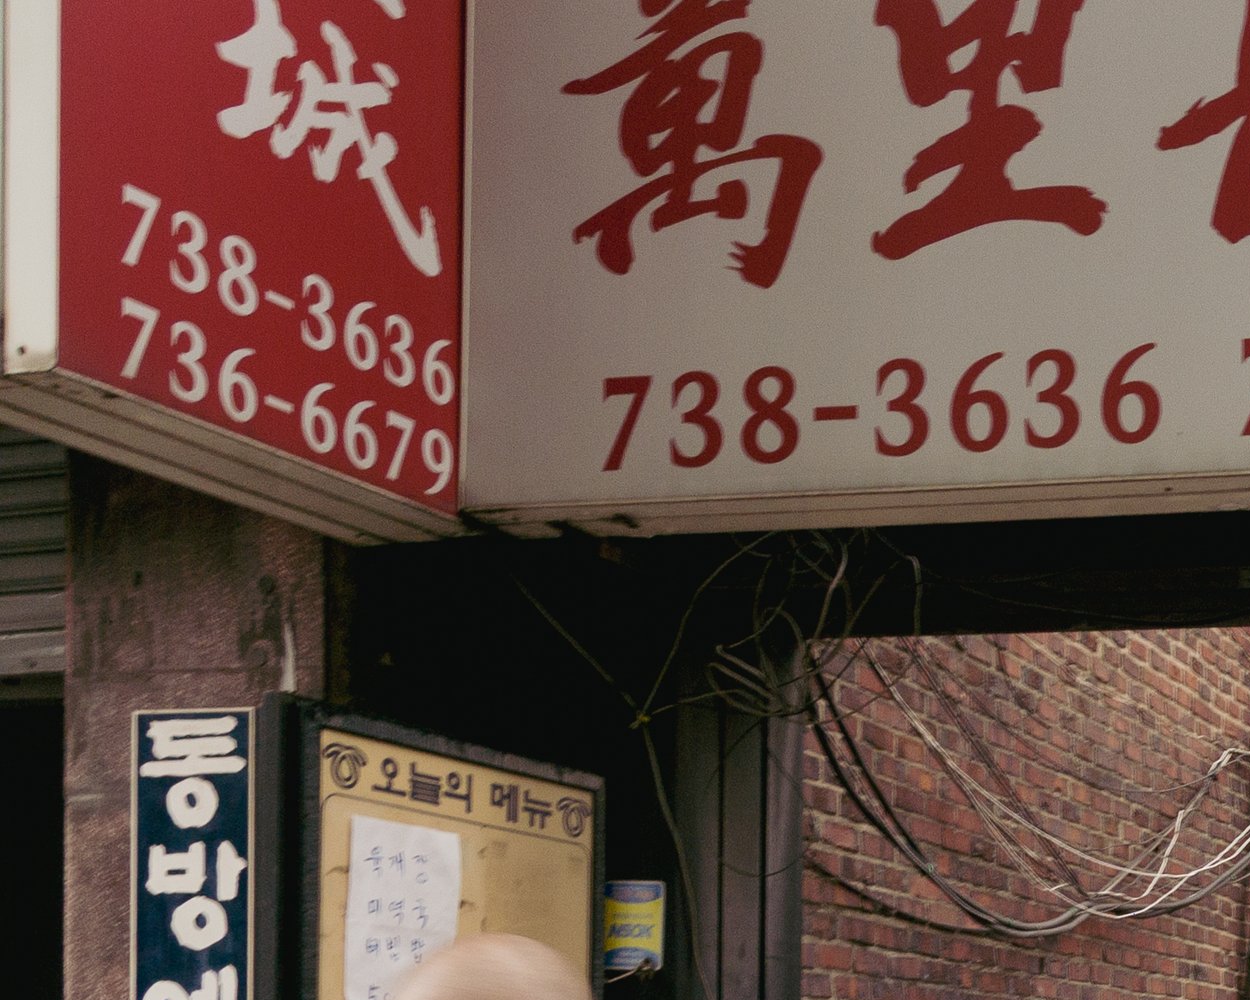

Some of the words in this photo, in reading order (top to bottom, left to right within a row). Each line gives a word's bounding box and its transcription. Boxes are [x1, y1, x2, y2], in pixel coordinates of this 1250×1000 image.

[215, 0, 442, 277] 城
[121, 184, 455, 405] 738-3636
[120, 297, 454, 495] 736-6679
[602, 343, 1162, 472] 738-3636
[371, 757, 473, 814] 오늘의
[490, 782, 553, 829] 메뉴
